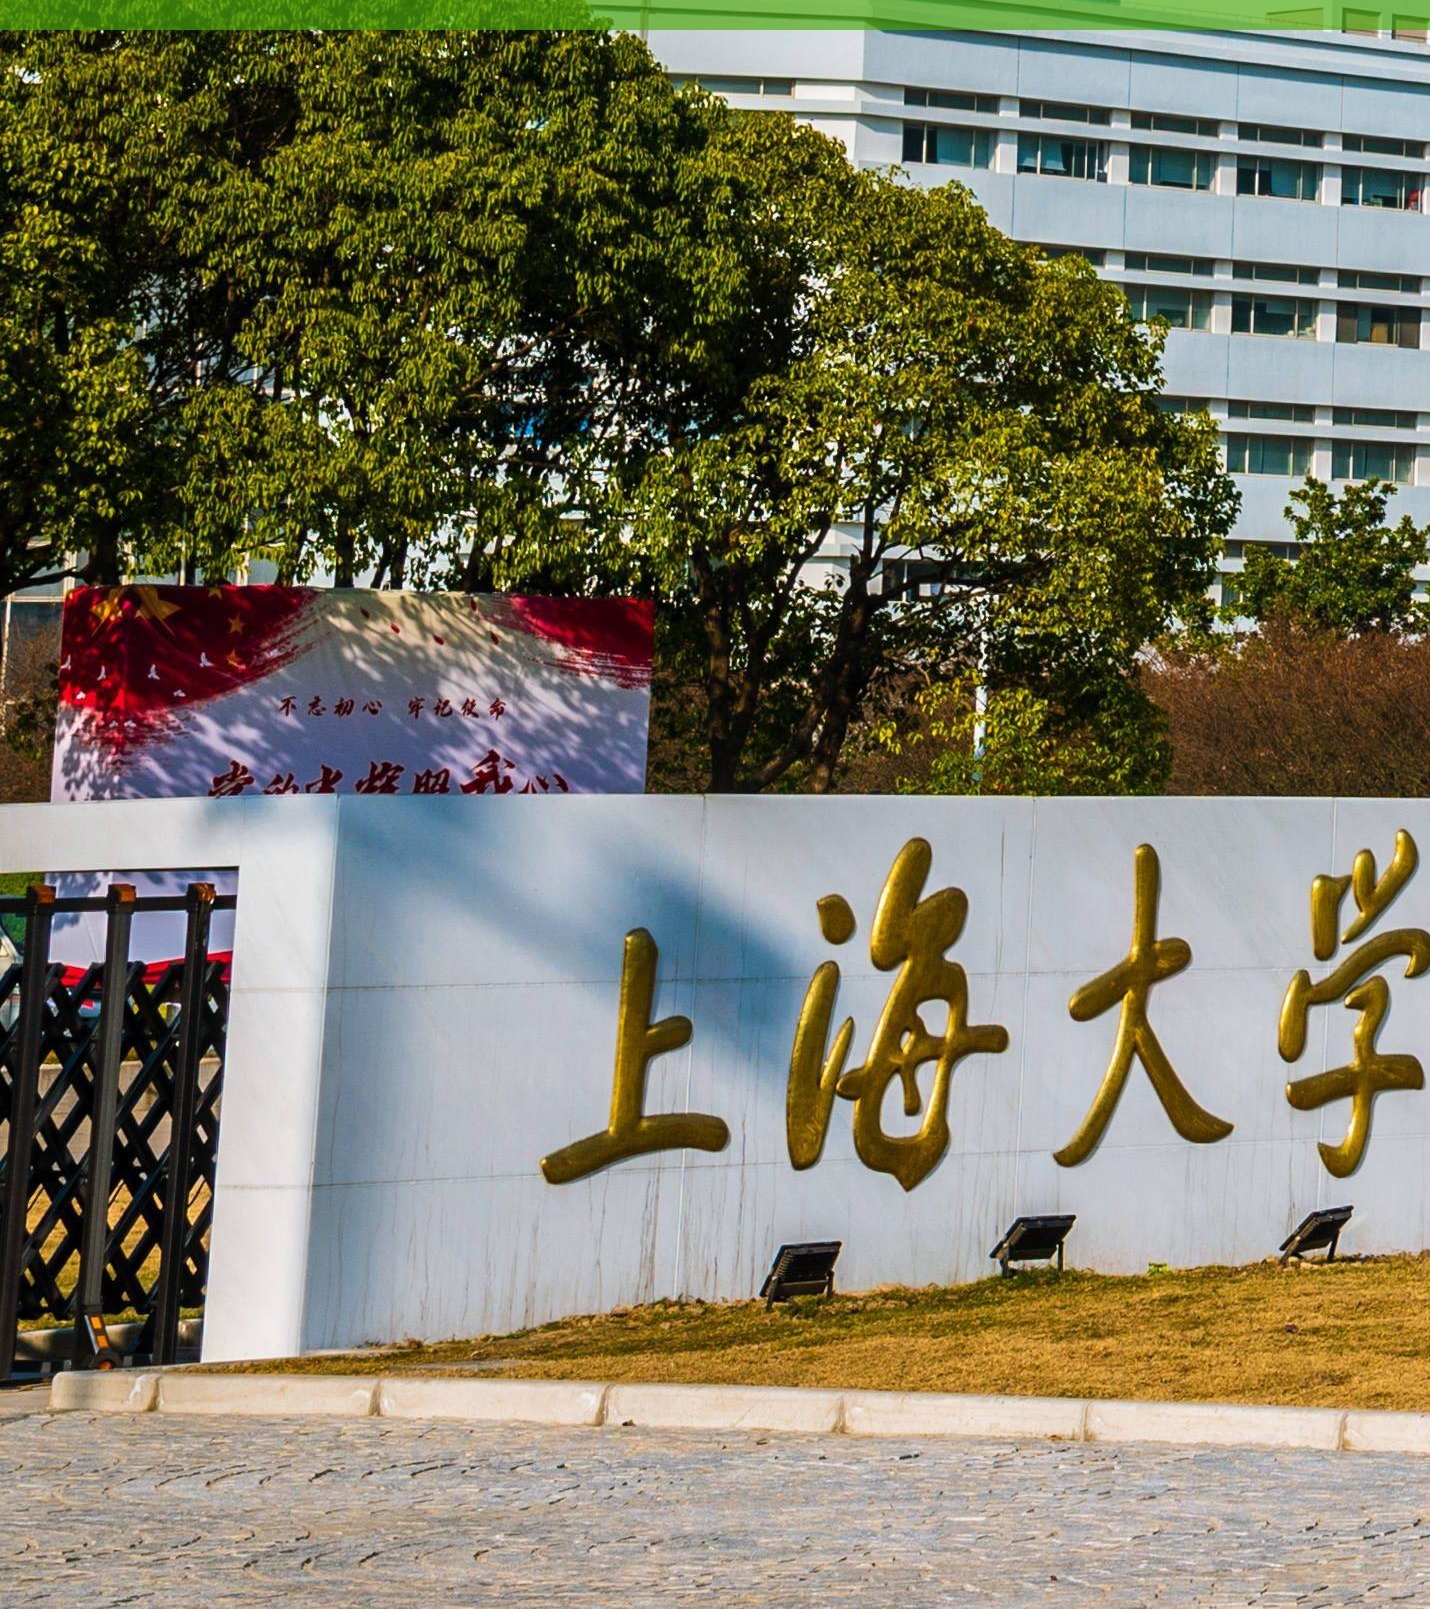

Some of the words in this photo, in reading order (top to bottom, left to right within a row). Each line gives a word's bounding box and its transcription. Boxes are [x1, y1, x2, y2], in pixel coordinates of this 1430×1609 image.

[278, 696, 383, 718] 不忘初心
[407, 696, 508, 721] 牢记使命
